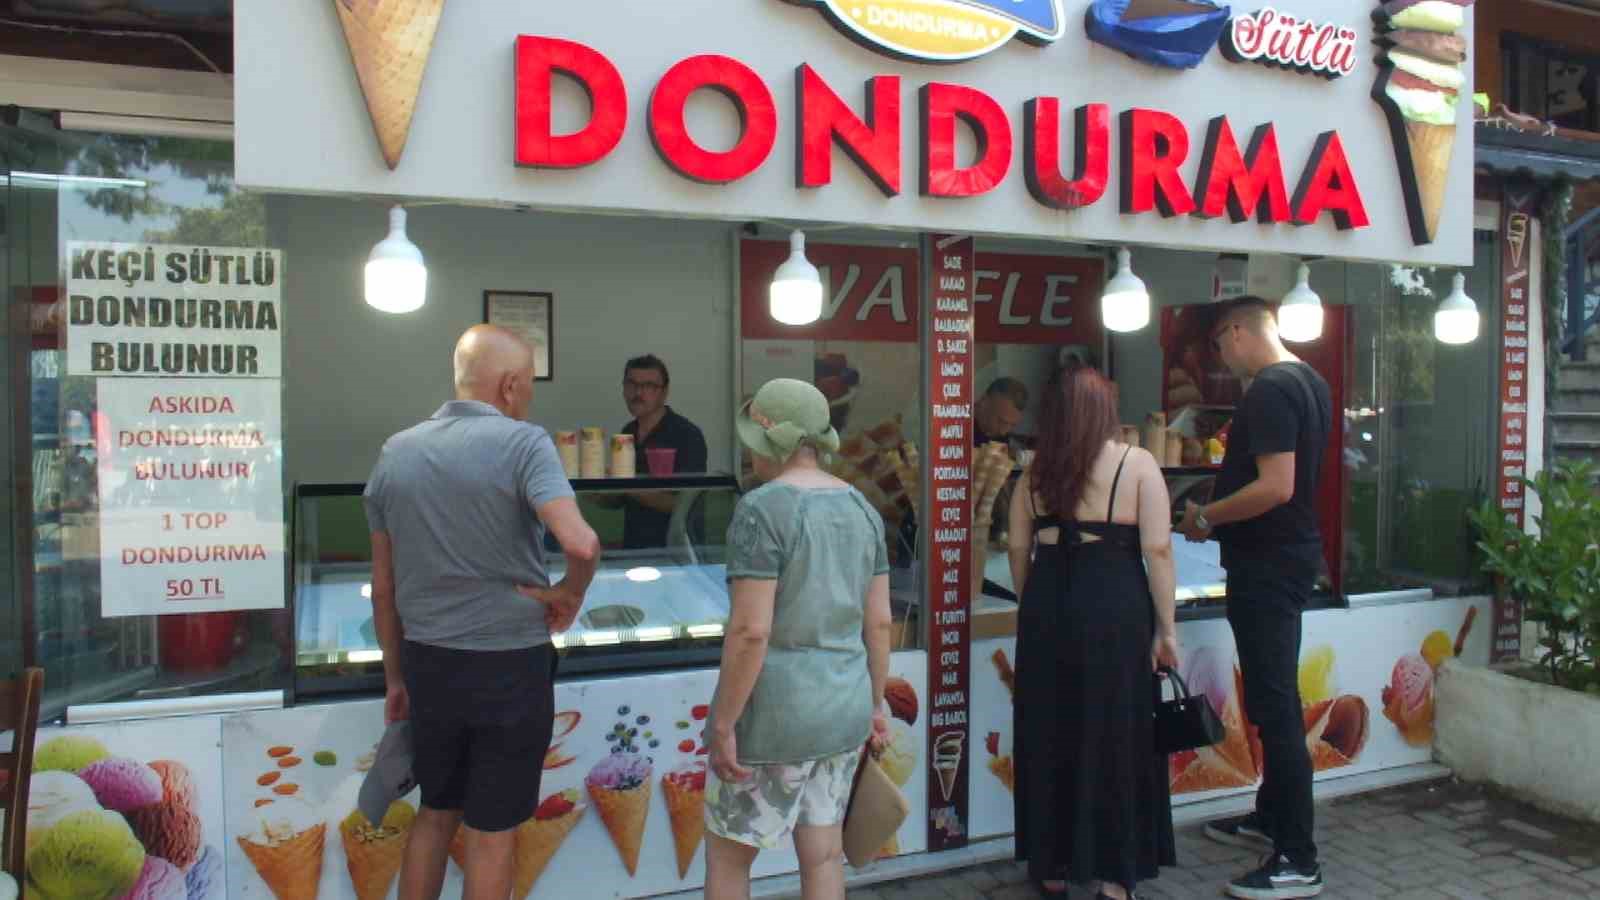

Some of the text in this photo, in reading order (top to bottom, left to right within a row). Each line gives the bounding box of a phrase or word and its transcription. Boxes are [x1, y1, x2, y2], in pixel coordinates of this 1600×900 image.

[867, 5, 988, 41] DONDURMA
[1234, 9, 1356, 72] Sütlü
[514, 34, 1370, 229] DONDURMA
[71, 246, 274, 288] KEÇİ SÜTLÜ
[70, 295, 278, 330] DONDURMA
[91, 342, 259, 374] BULUNUR
[149, 396, 235, 415] ASKIDA
[119, 428, 265, 448] DONDURMA
[136, 462, 250, 481] BULUNUR
[162, 512, 227, 530] 1 TOP
[121, 545, 267, 565] DONDURMA
[166, 579, 225, 597] 50 TL
